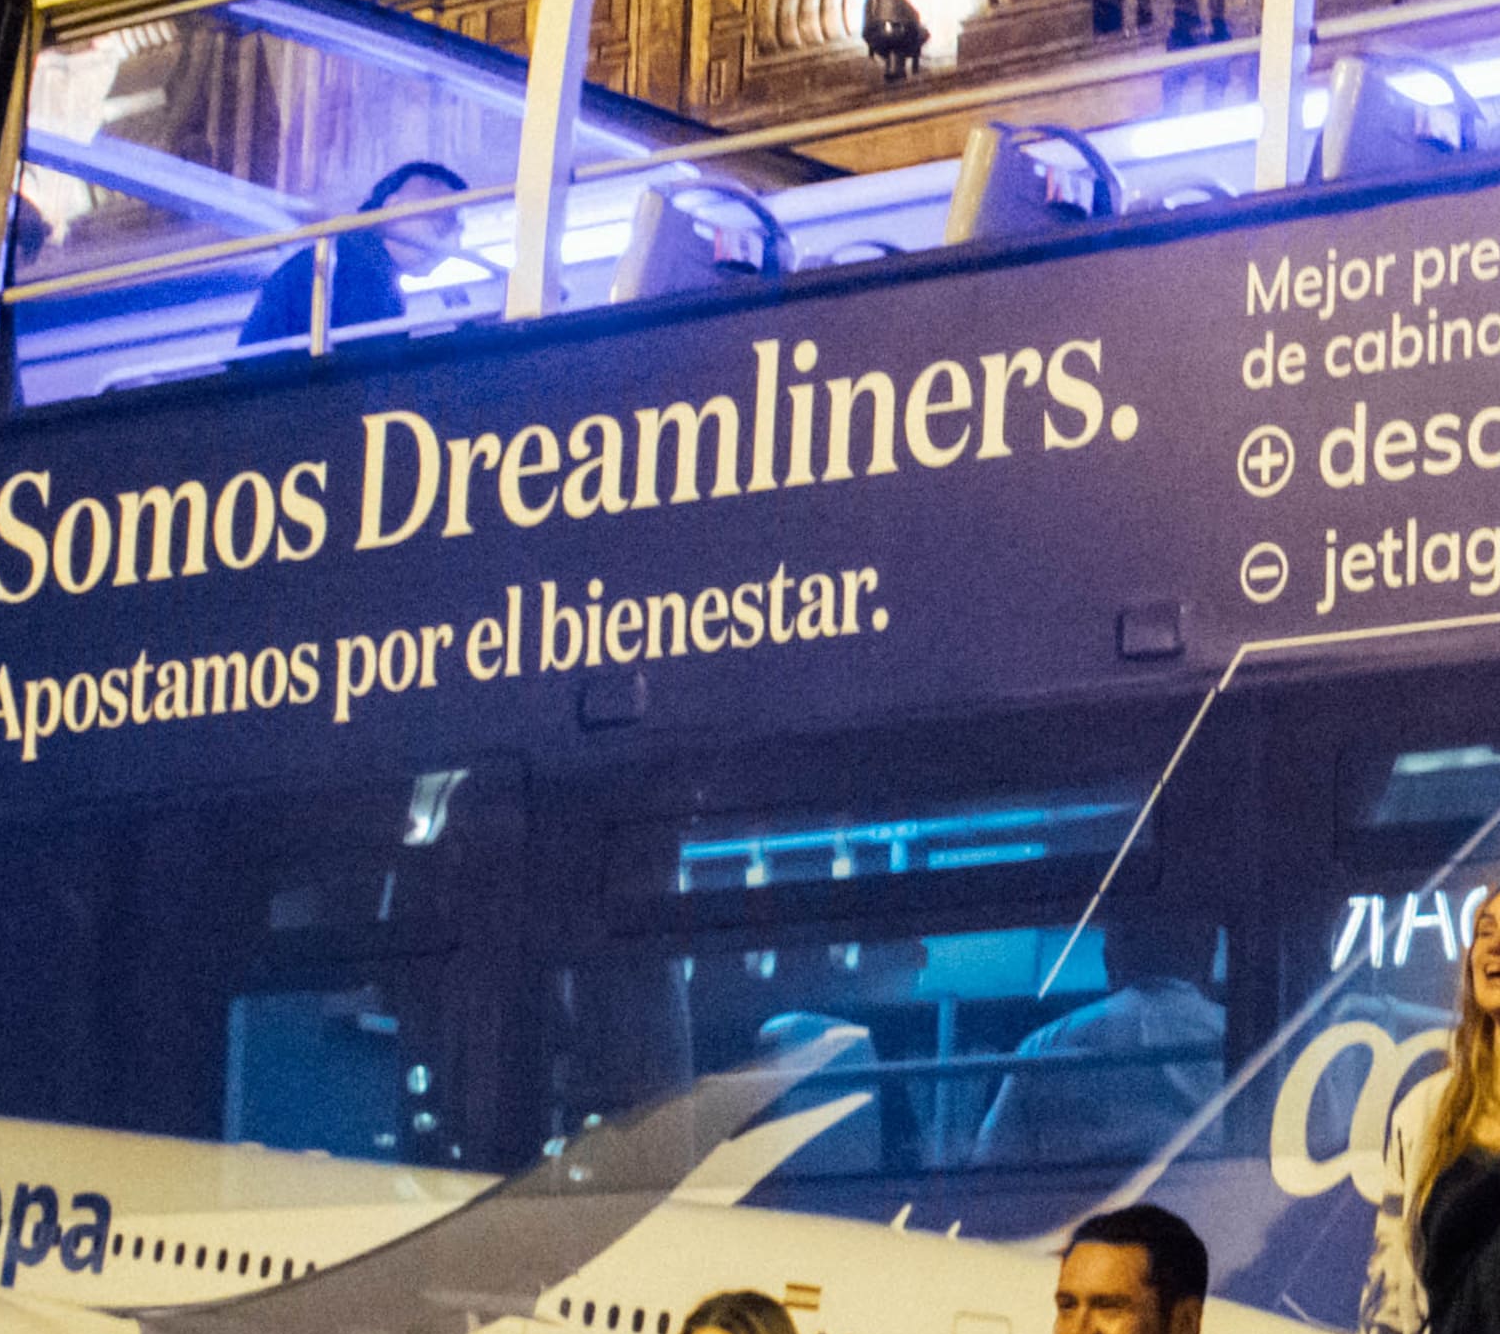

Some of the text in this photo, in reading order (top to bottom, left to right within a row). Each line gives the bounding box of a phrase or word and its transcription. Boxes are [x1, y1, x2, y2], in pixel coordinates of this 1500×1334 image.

[1245, 248, 1396, 321] Mejor
[1241, 331, 1307, 390] de
[355, 339, 1139, 551] Dreamliners.
[333, 623, 454, 723] por
[466, 585, 522, 681] el
[539, 561, 890, 673] bienestar.
